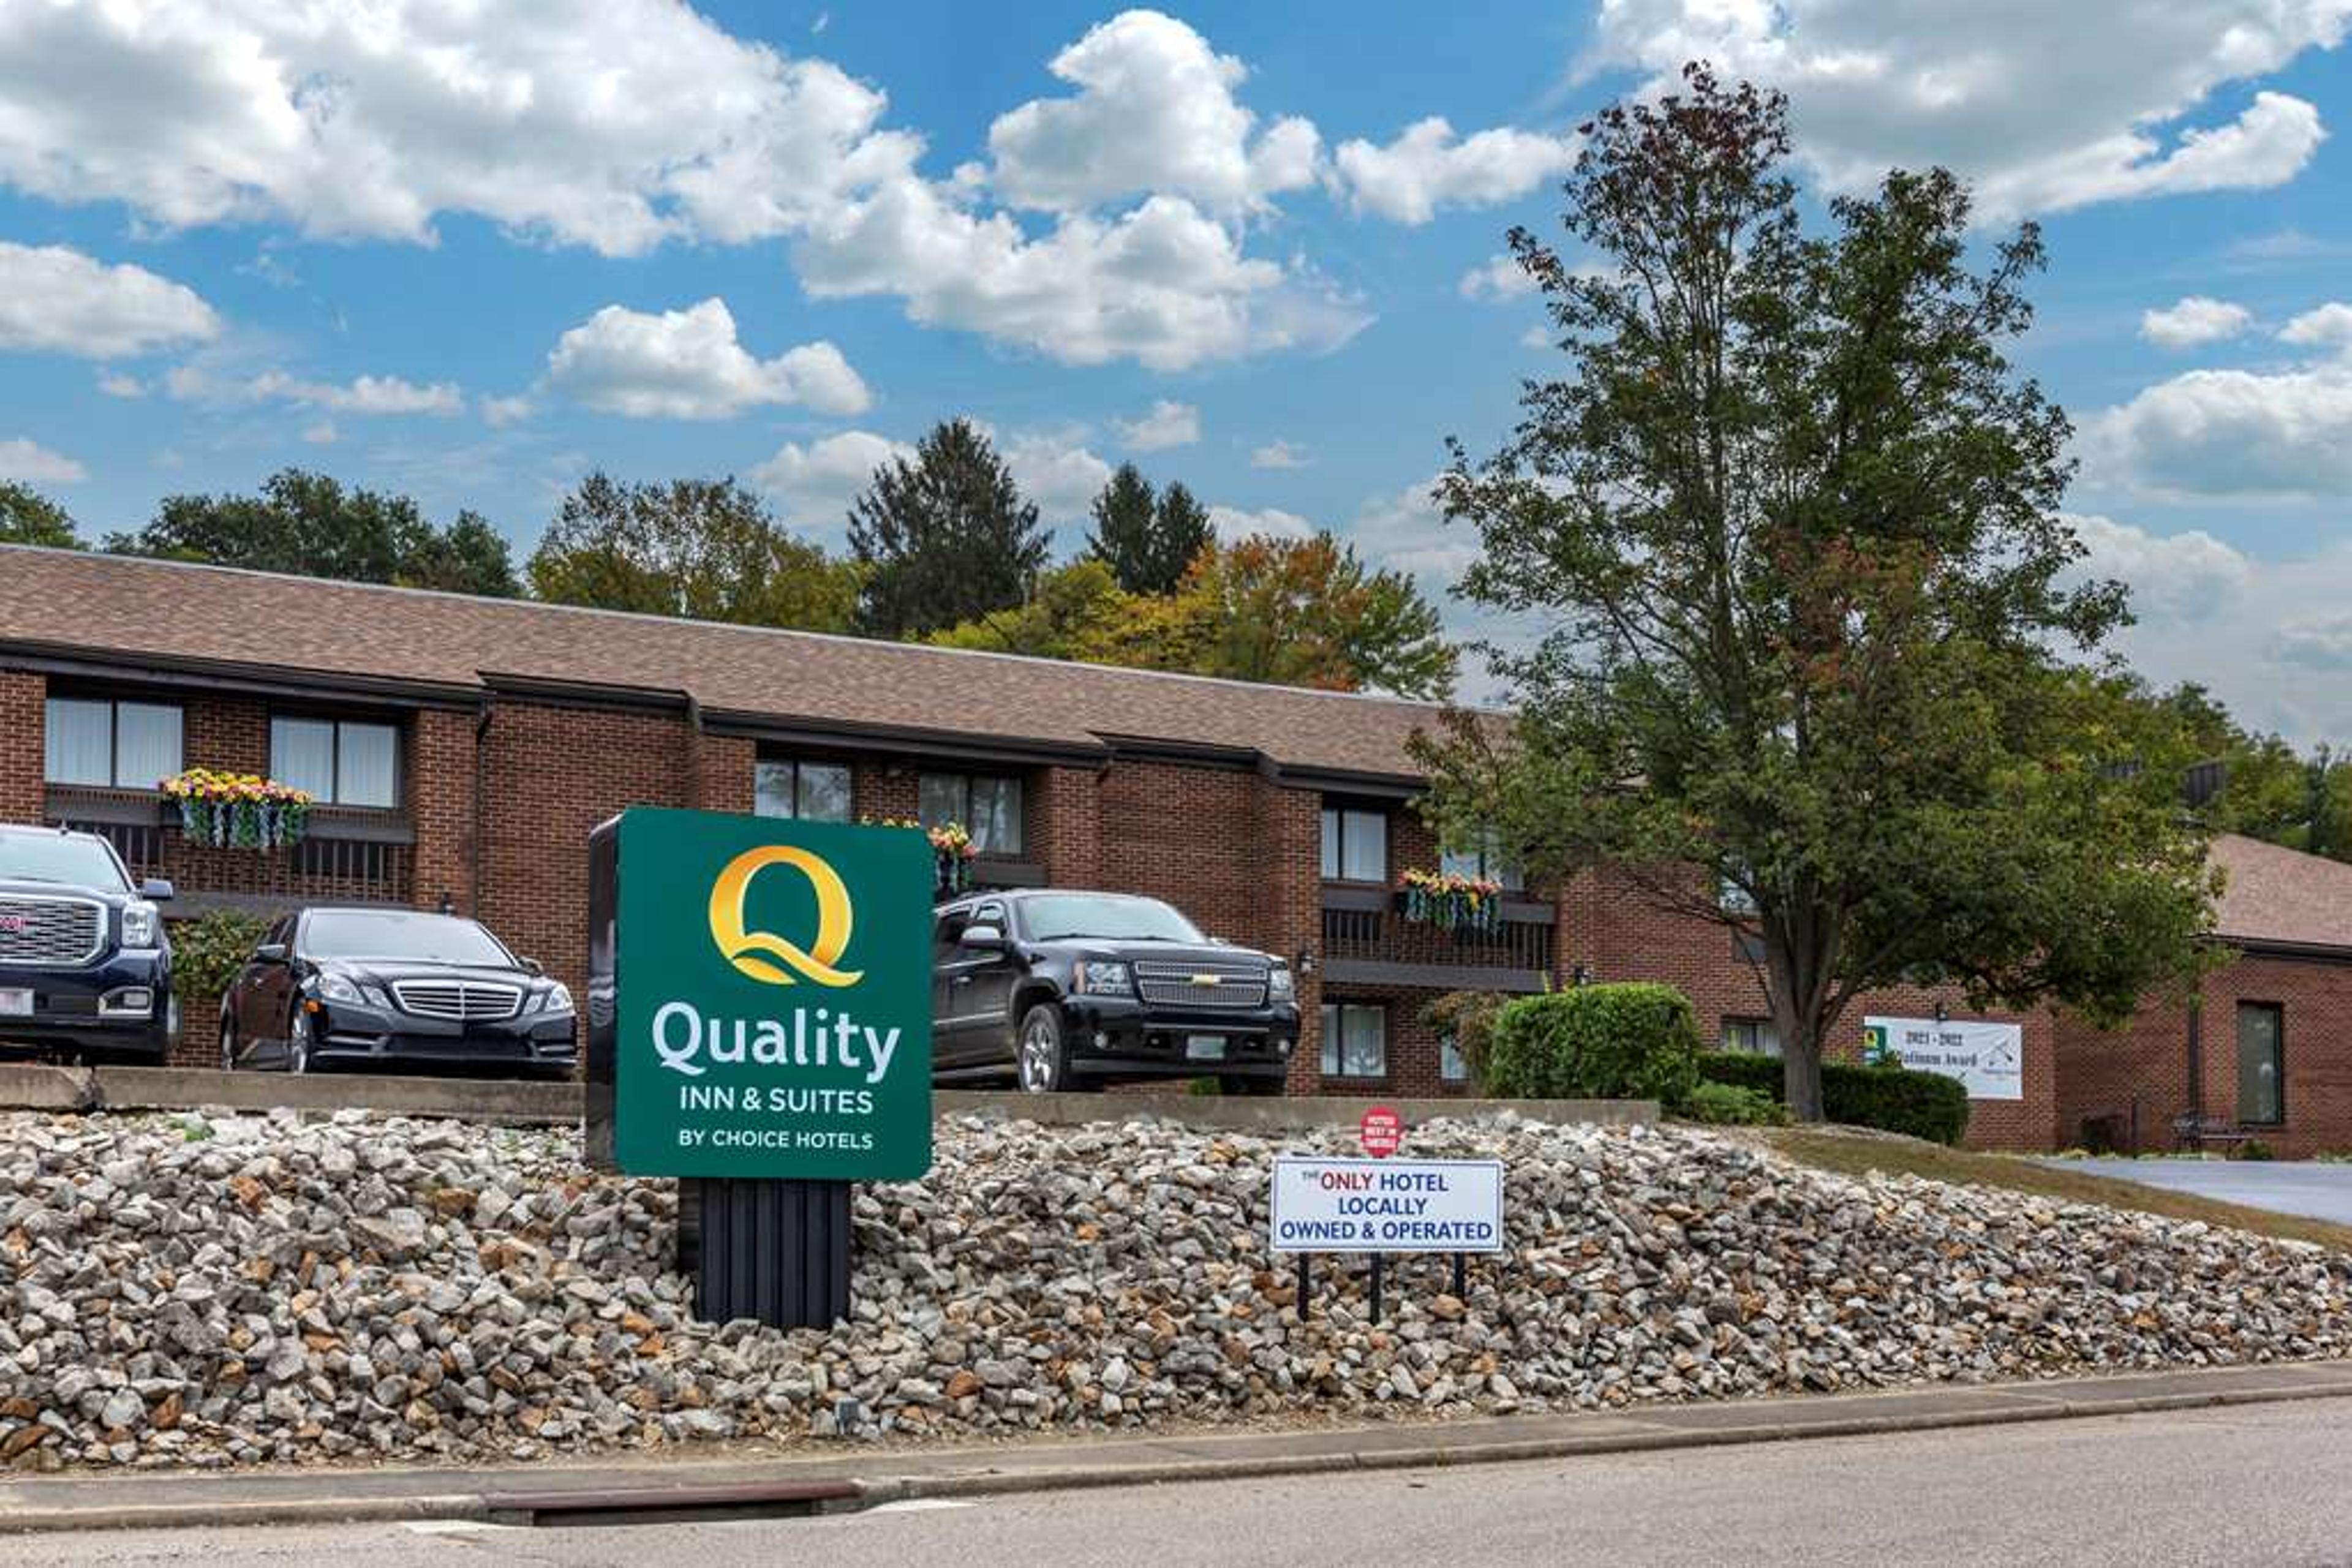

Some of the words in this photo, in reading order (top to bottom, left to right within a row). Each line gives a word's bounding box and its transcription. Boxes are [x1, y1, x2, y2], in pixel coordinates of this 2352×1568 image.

[709, 845, 864, 987] Q
[652, 1001, 902, 1084] Quality
[680, 1086, 734, 1111] INN
[742, 1087, 762, 1111] &
[769, 1088, 873, 1115] SUITES
[679, 1130, 704, 1146] BY
[712, 1130, 790, 1148] CHOICE
[797, 1133, 873, 1150] HOTELS
[1321, 1172, 1373, 1190] ONLY
[1380, 1174, 1449, 1192] HOTEL
[1339, 1197, 1428, 1215] LOCALLY
[1280, 1221, 1354, 1239] OWNED
[1362, 1222, 1376, 1239] &
[1382, 1222, 1493, 1240] OPERATED
